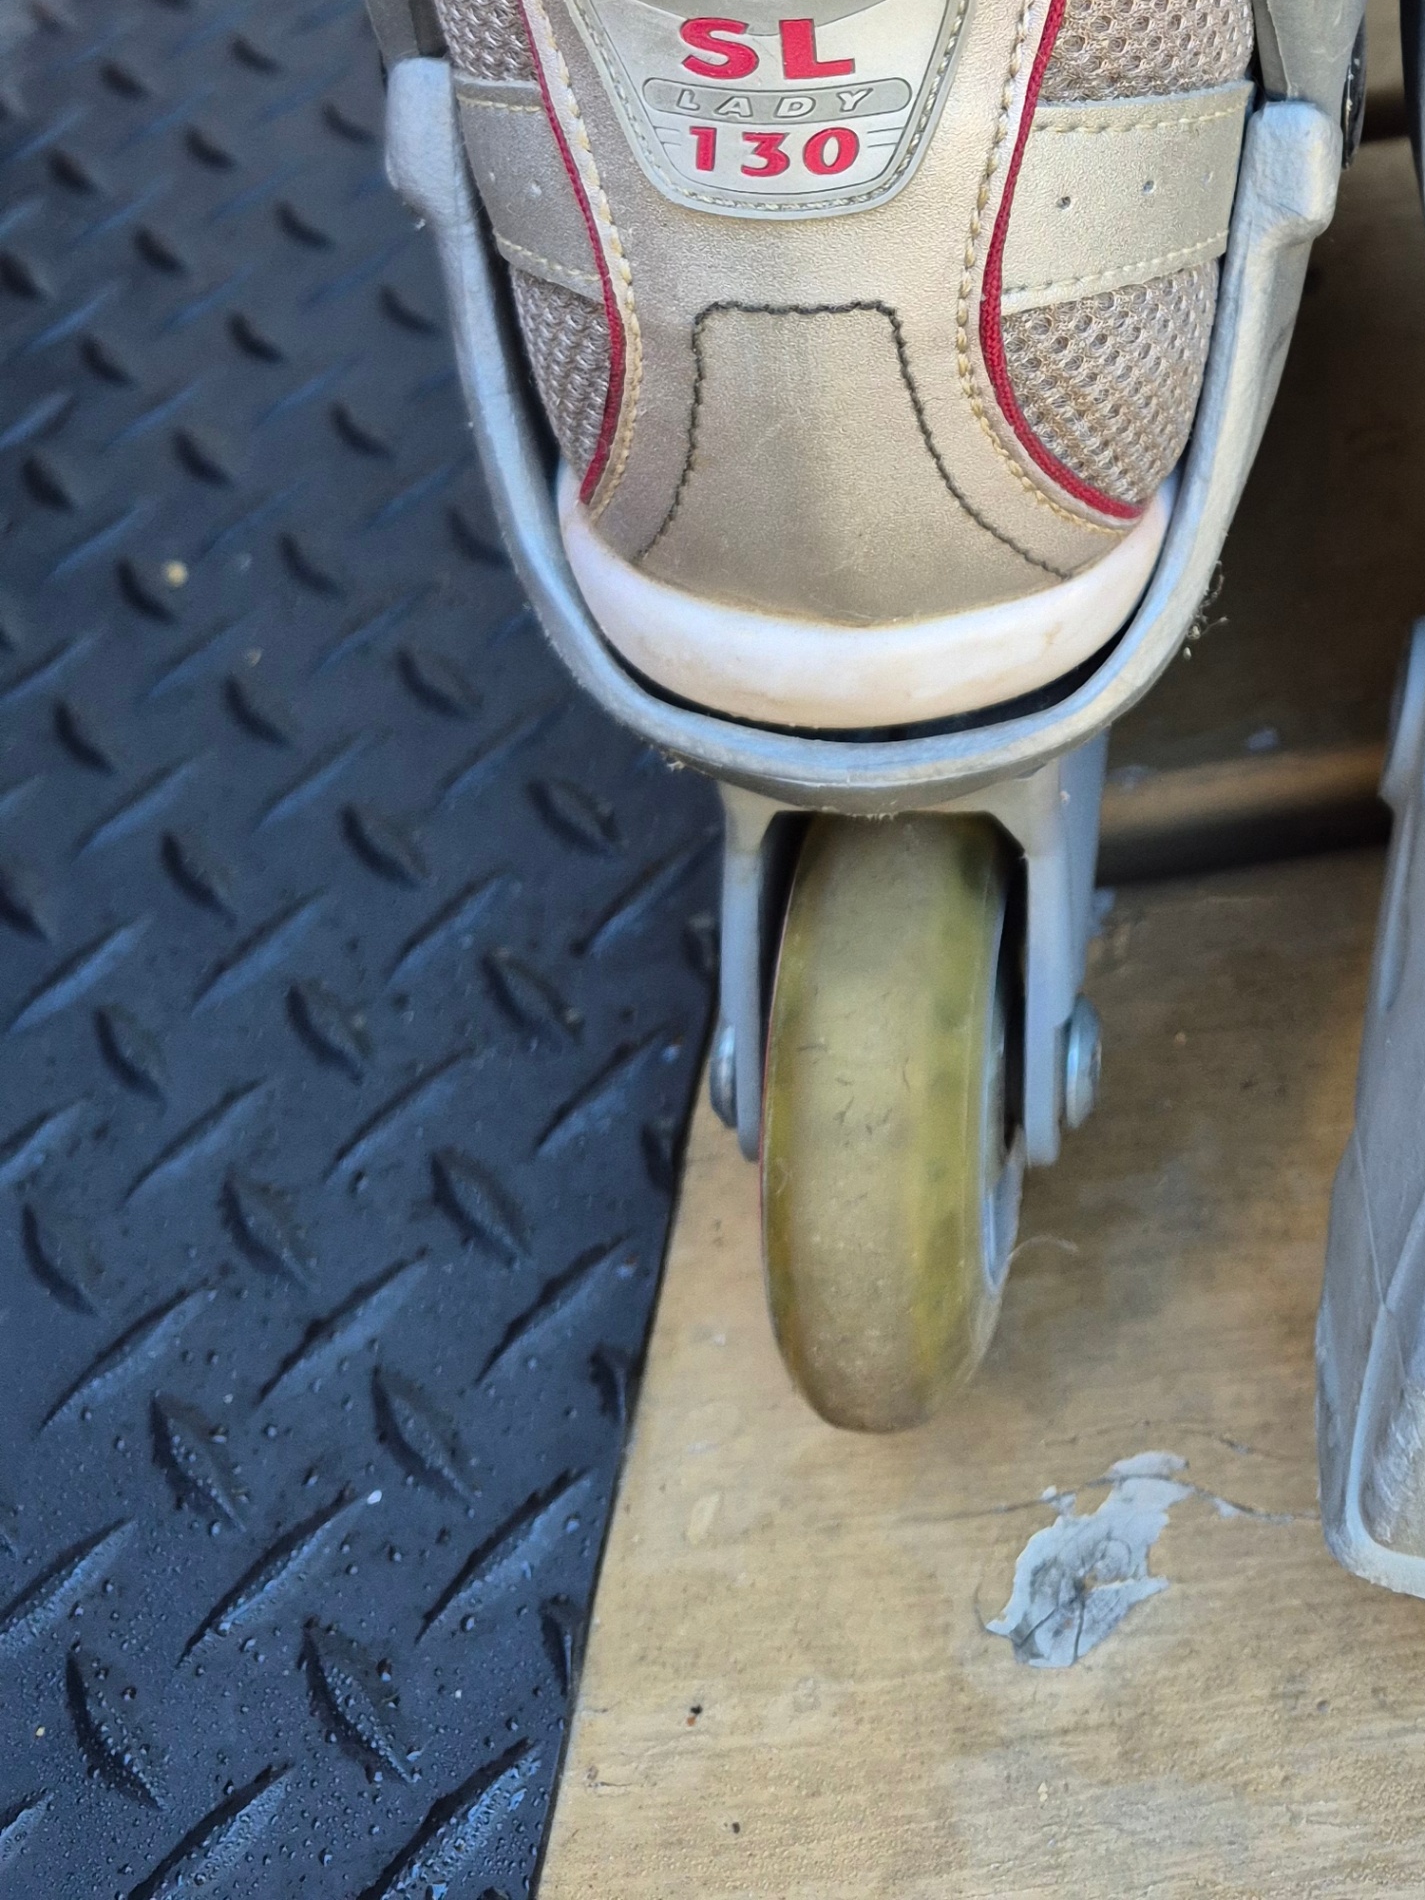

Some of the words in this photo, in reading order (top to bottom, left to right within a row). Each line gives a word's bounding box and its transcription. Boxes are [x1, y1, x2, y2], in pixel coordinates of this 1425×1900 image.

[679, 16, 856, 81] SL
[675, 87, 874, 119] LADY
[688, 126, 860, 178] 130
